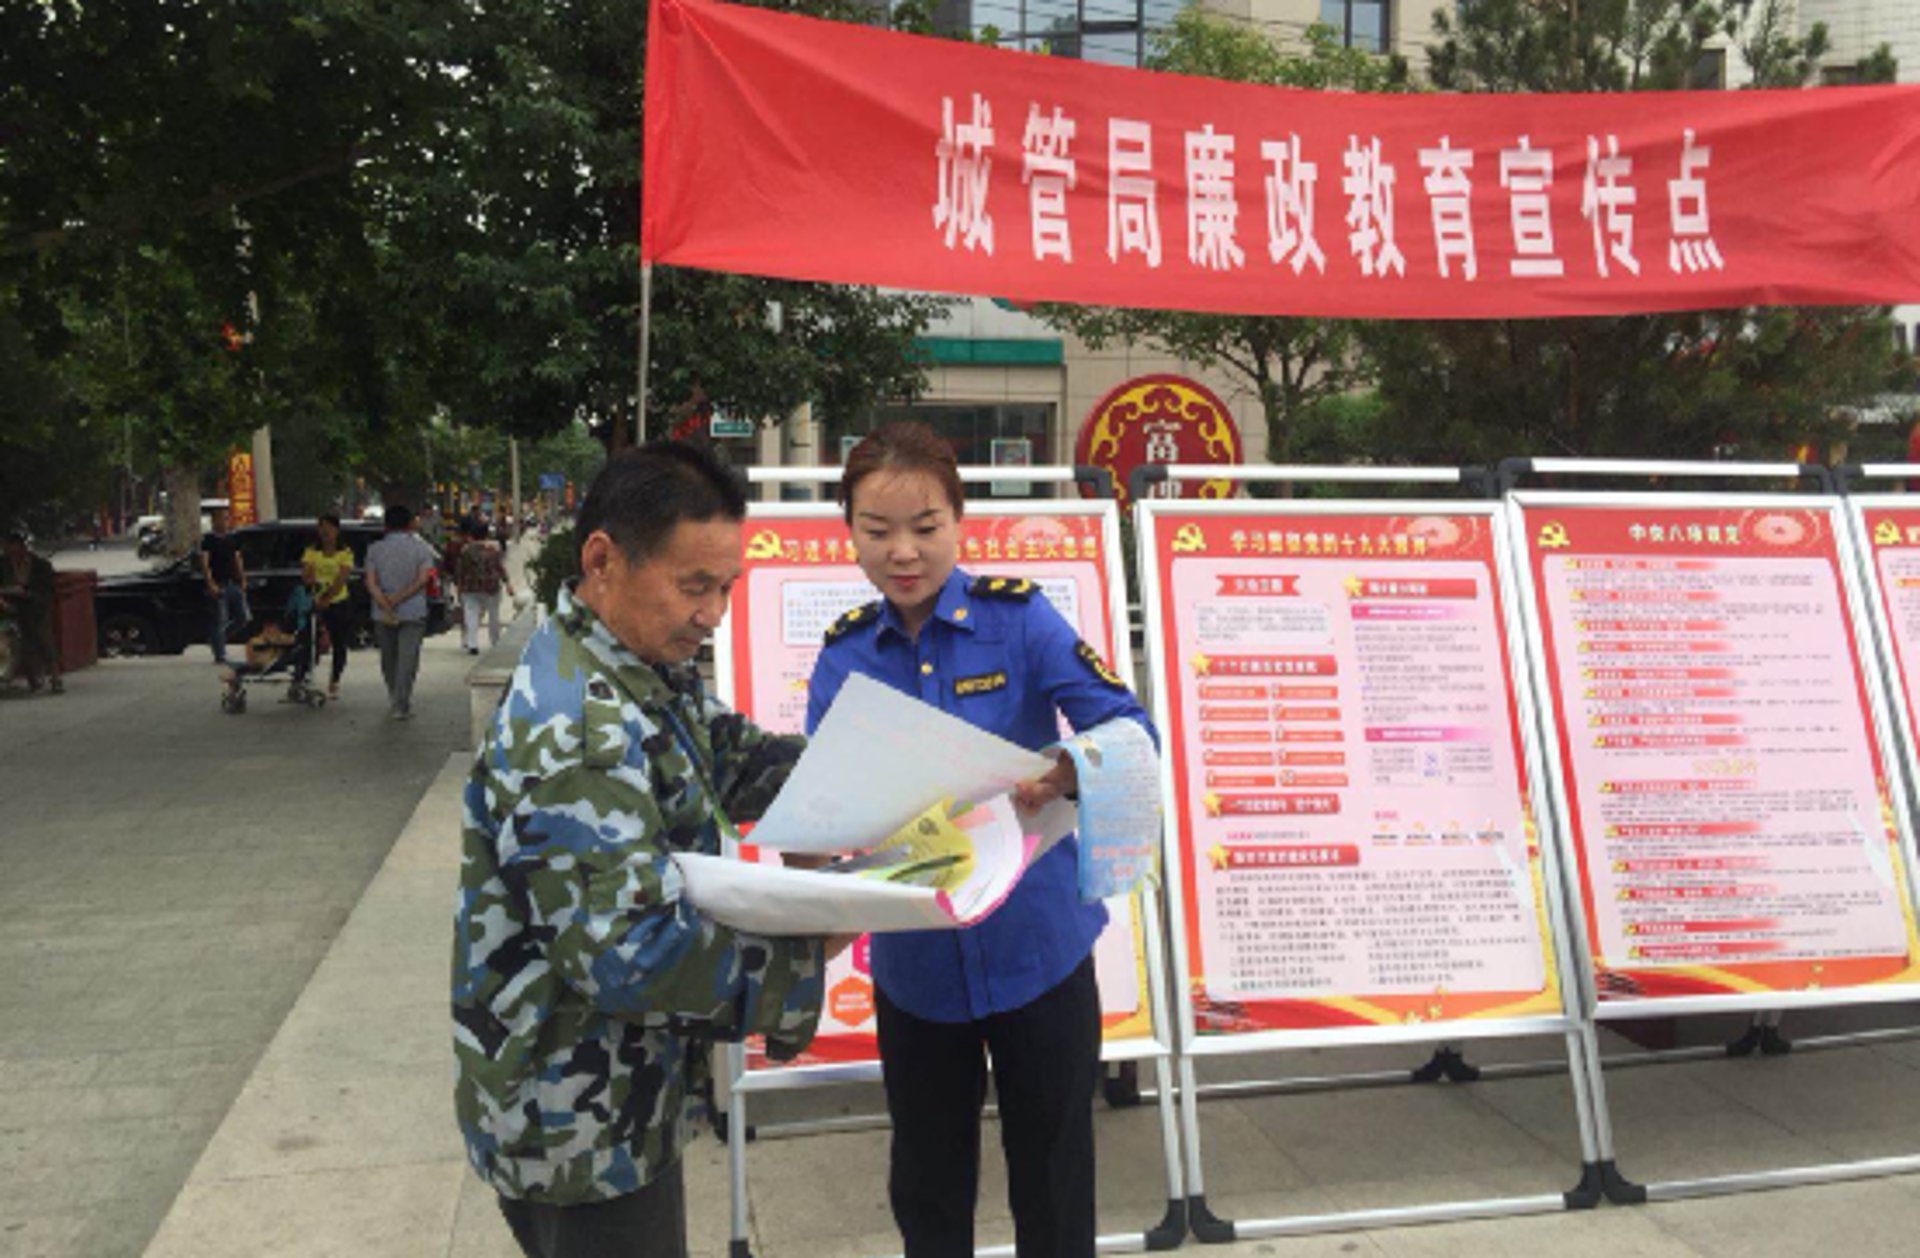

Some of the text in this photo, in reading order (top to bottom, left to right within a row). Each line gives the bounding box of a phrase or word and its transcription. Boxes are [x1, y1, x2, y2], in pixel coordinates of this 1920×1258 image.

[932, 92, 1726, 283] 城管局廉政教育宣传点
[956, 535, 1097, 560] 色社会主义思想
